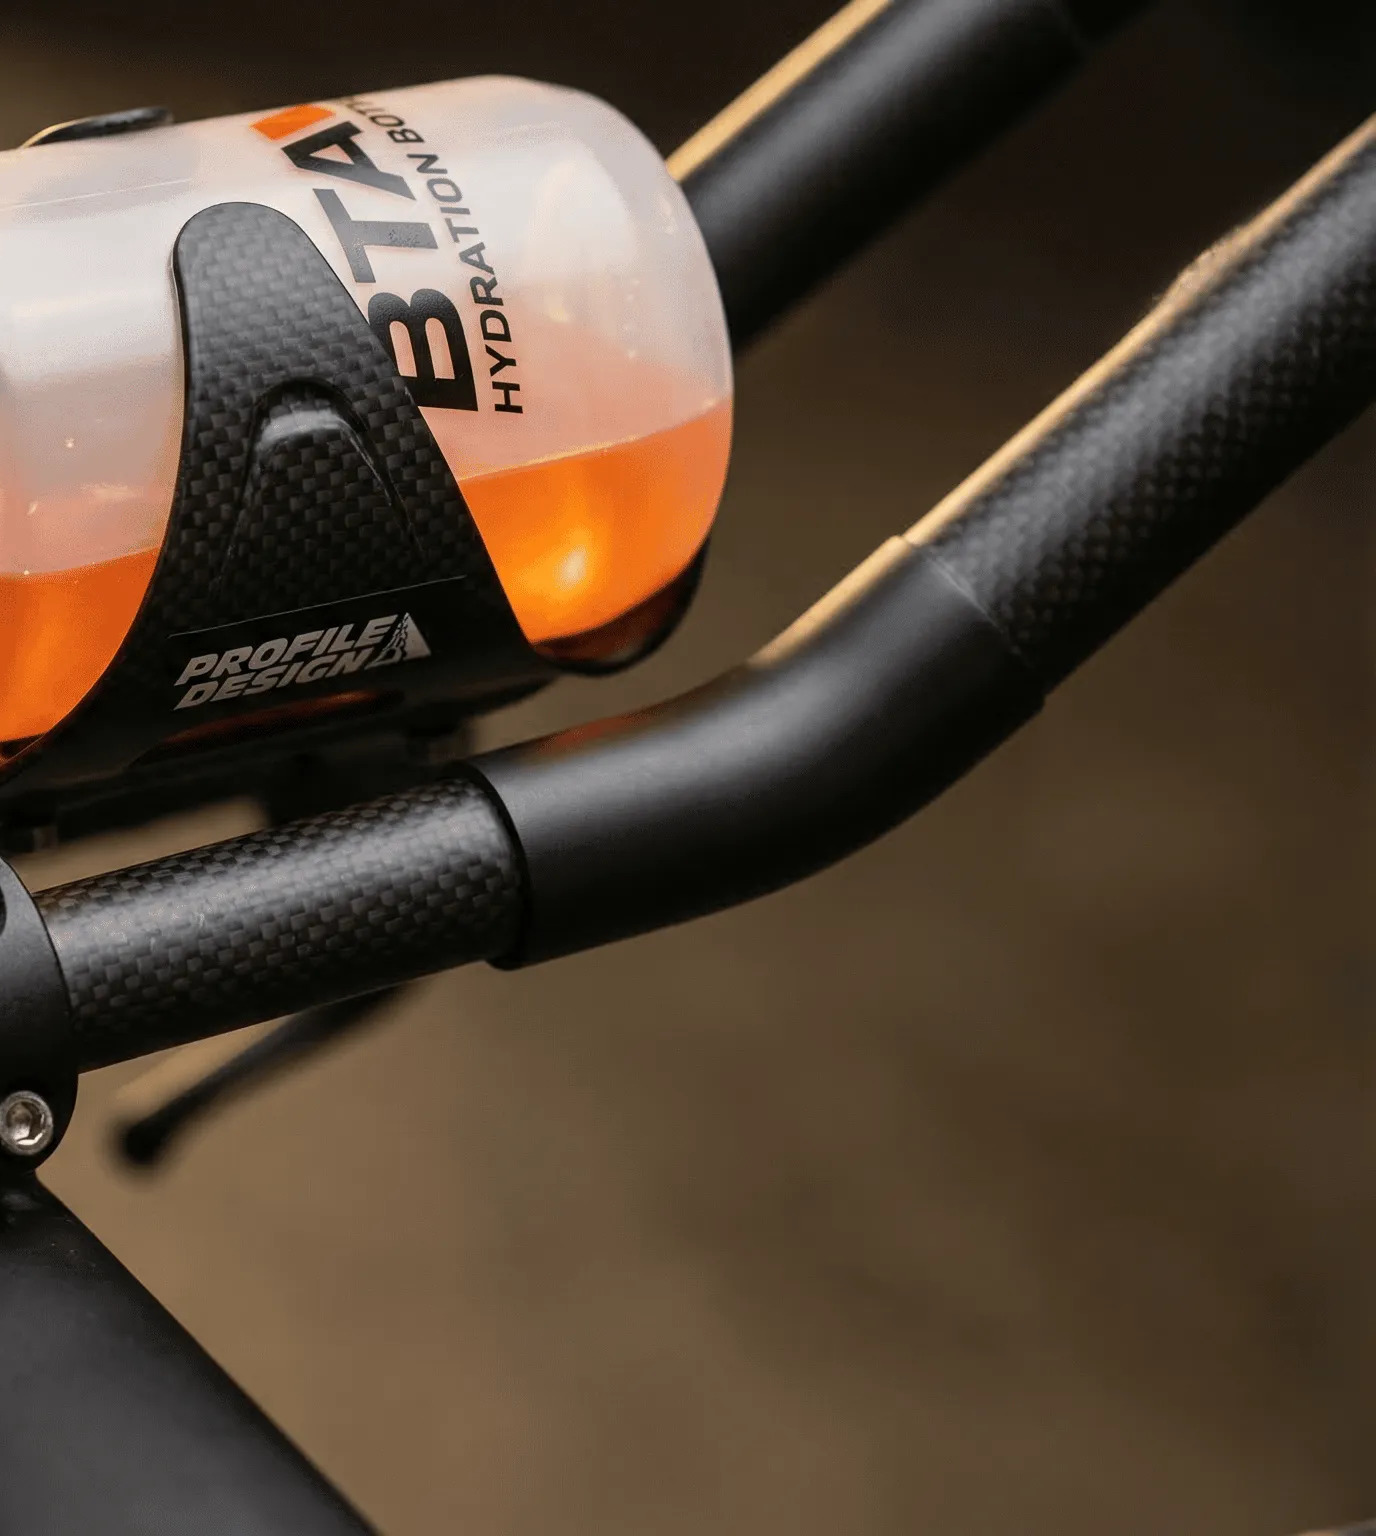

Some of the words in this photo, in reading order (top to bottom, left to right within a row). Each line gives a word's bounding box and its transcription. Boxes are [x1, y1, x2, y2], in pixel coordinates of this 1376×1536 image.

[281, 121, 478, 411] BTA
[406, 153, 523, 414] HYDRATION
[174, 614, 399, 686] PROFILE
[174, 647, 375, 711] DESIGN
